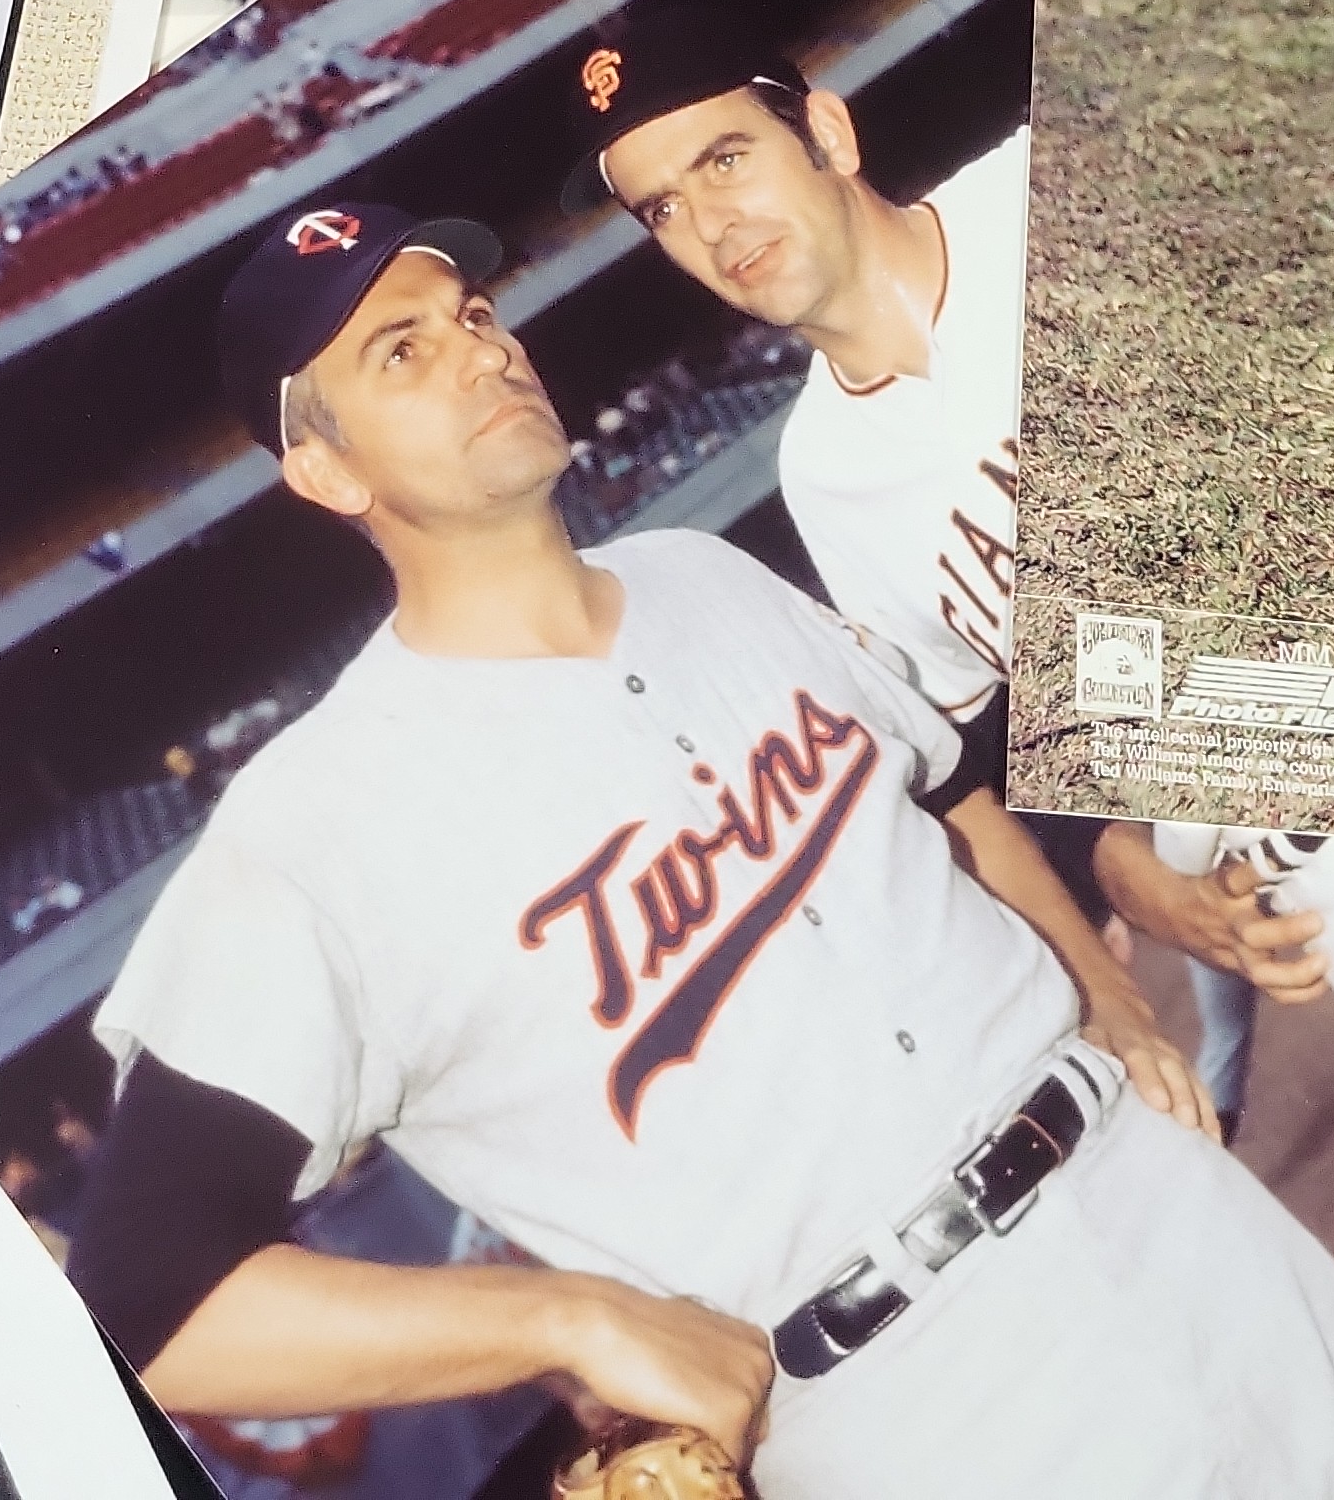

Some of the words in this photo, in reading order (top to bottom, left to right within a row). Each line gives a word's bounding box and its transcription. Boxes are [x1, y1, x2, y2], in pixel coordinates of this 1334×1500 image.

[1169, 695, 1276, 723] Photo
[1090, 721, 1124, 739] The
[1227, 737, 1296, 758] property
[1090, 740, 1122, 760] Ted
[1125, 743, 1197, 765] Williams
[1090, 760, 1121, 780] Ted
[518, 687, 880, 1029] Twins
